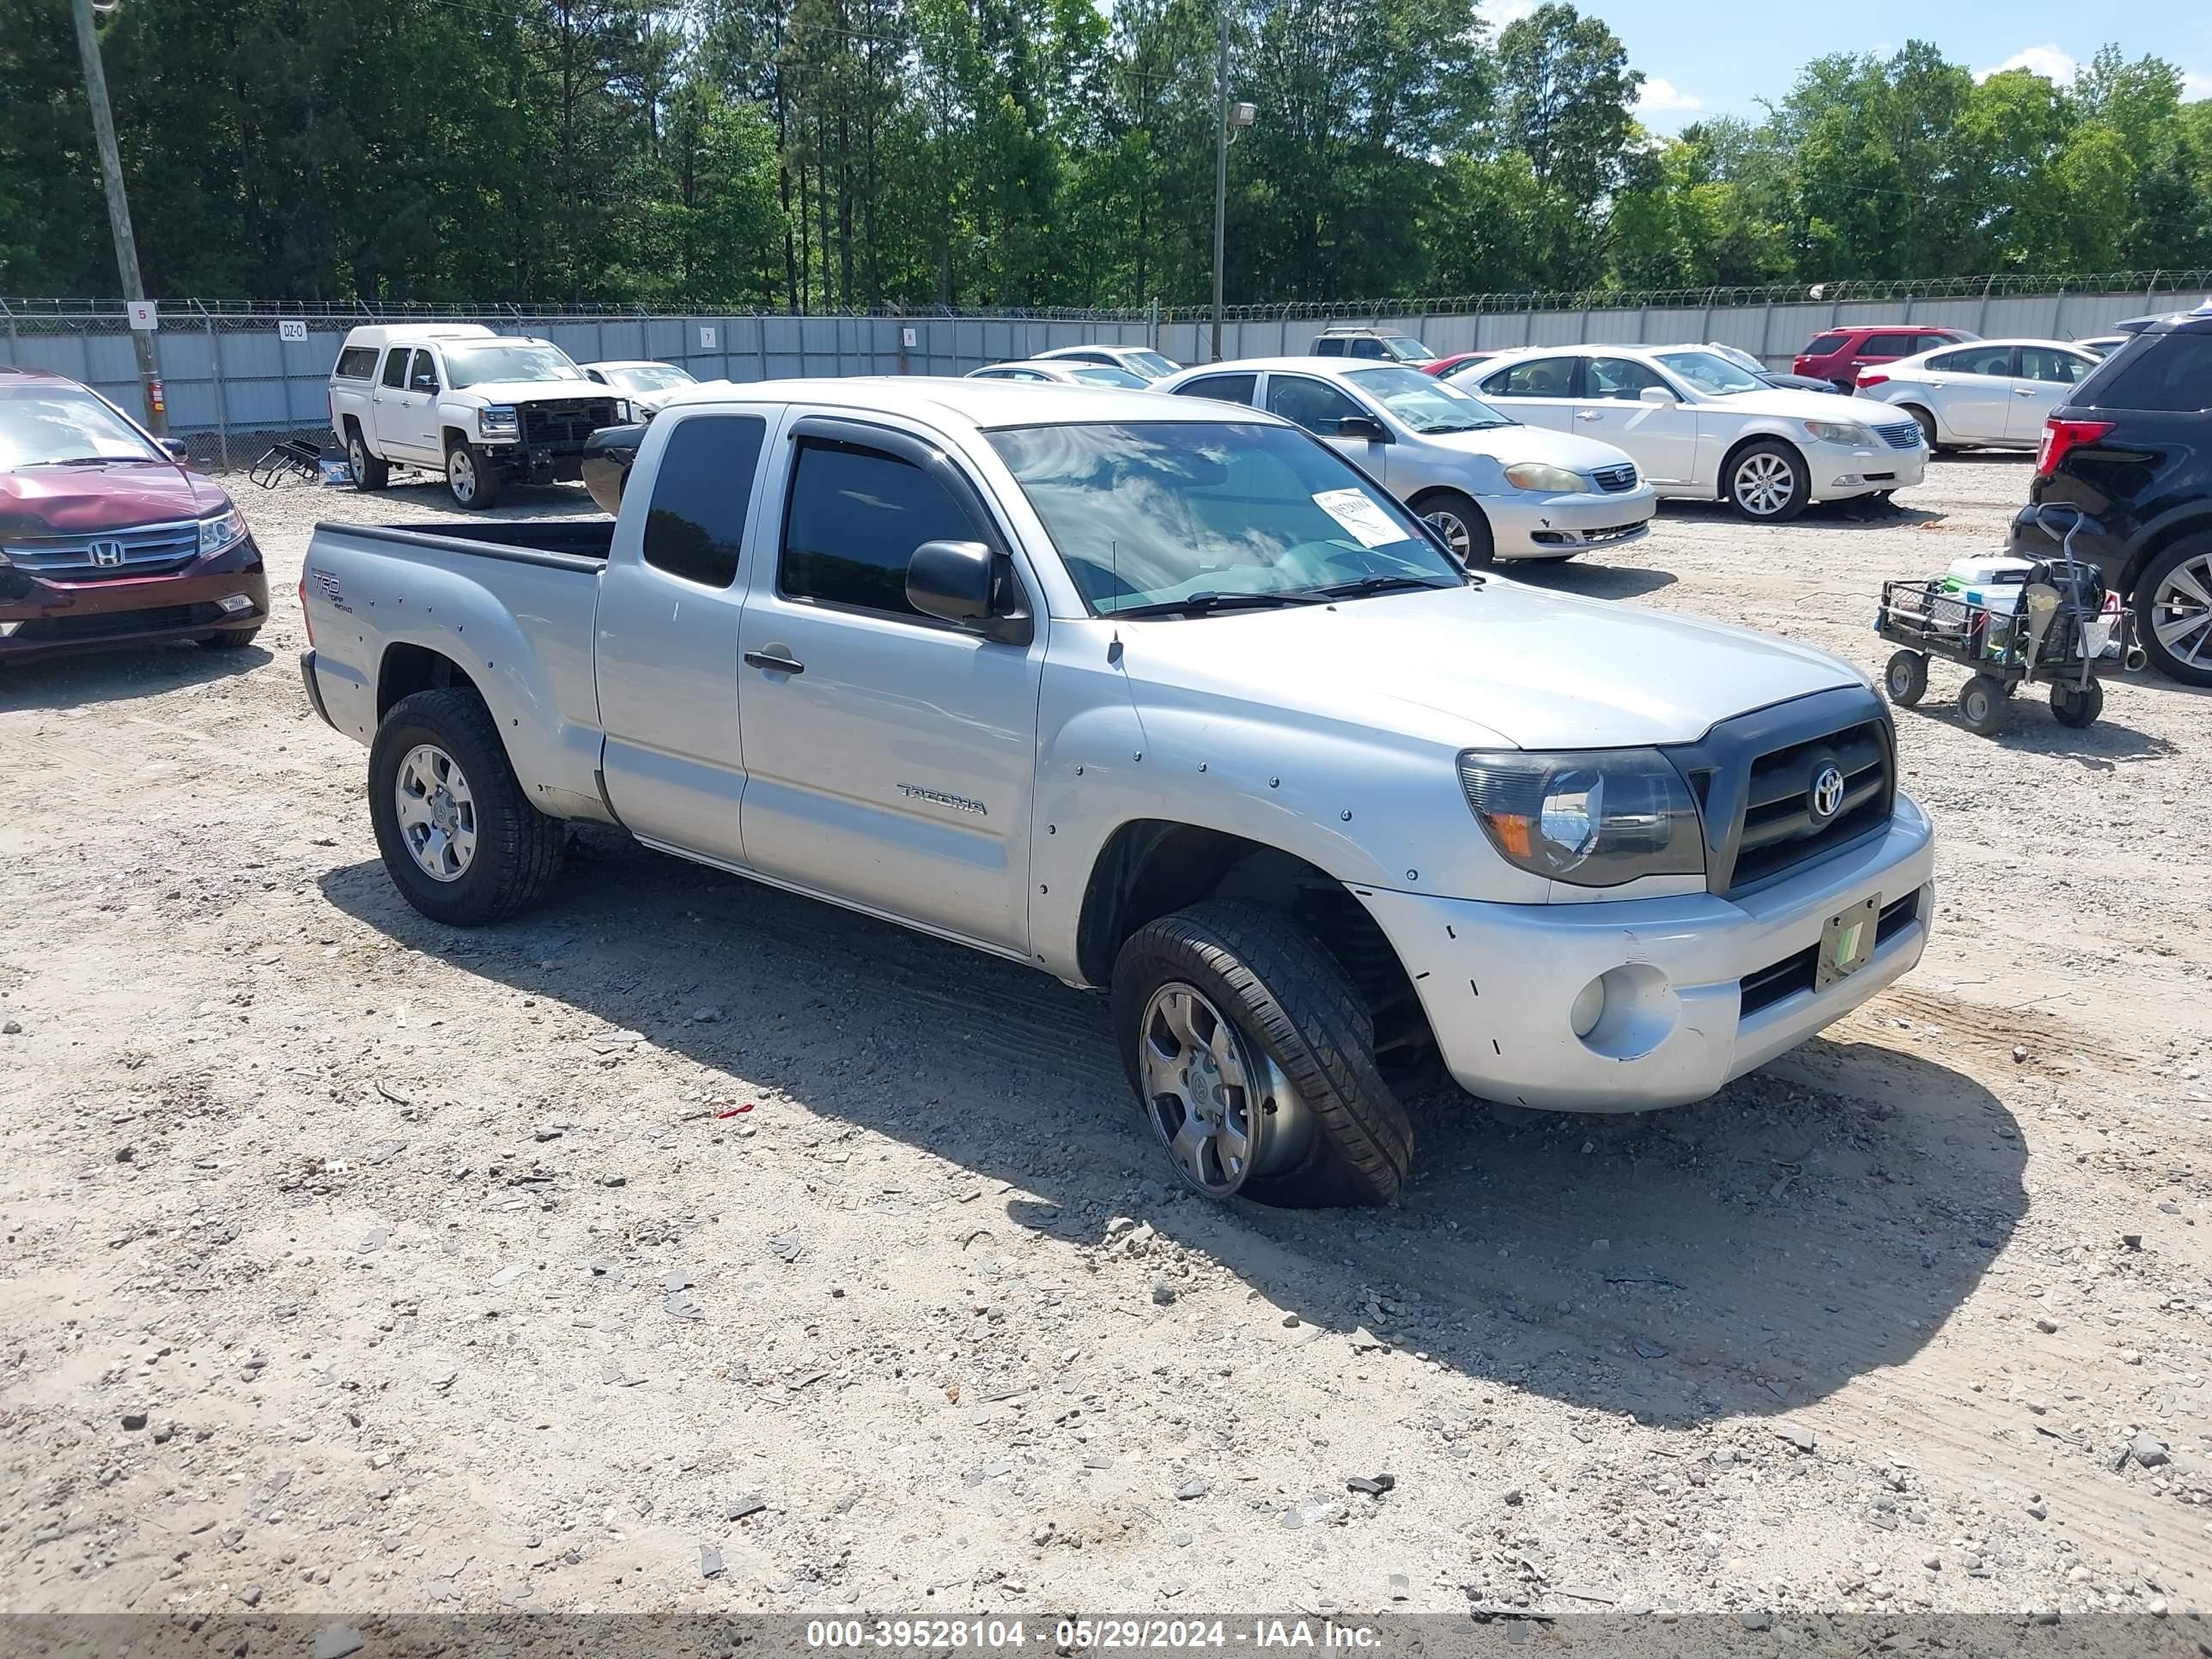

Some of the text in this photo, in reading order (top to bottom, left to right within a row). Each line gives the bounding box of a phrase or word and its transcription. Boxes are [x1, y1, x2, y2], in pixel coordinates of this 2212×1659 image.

[138, 309, 147, 319] 5
[313, 573, 340, 594] TRD
[896, 782, 988, 816] TACOMA
